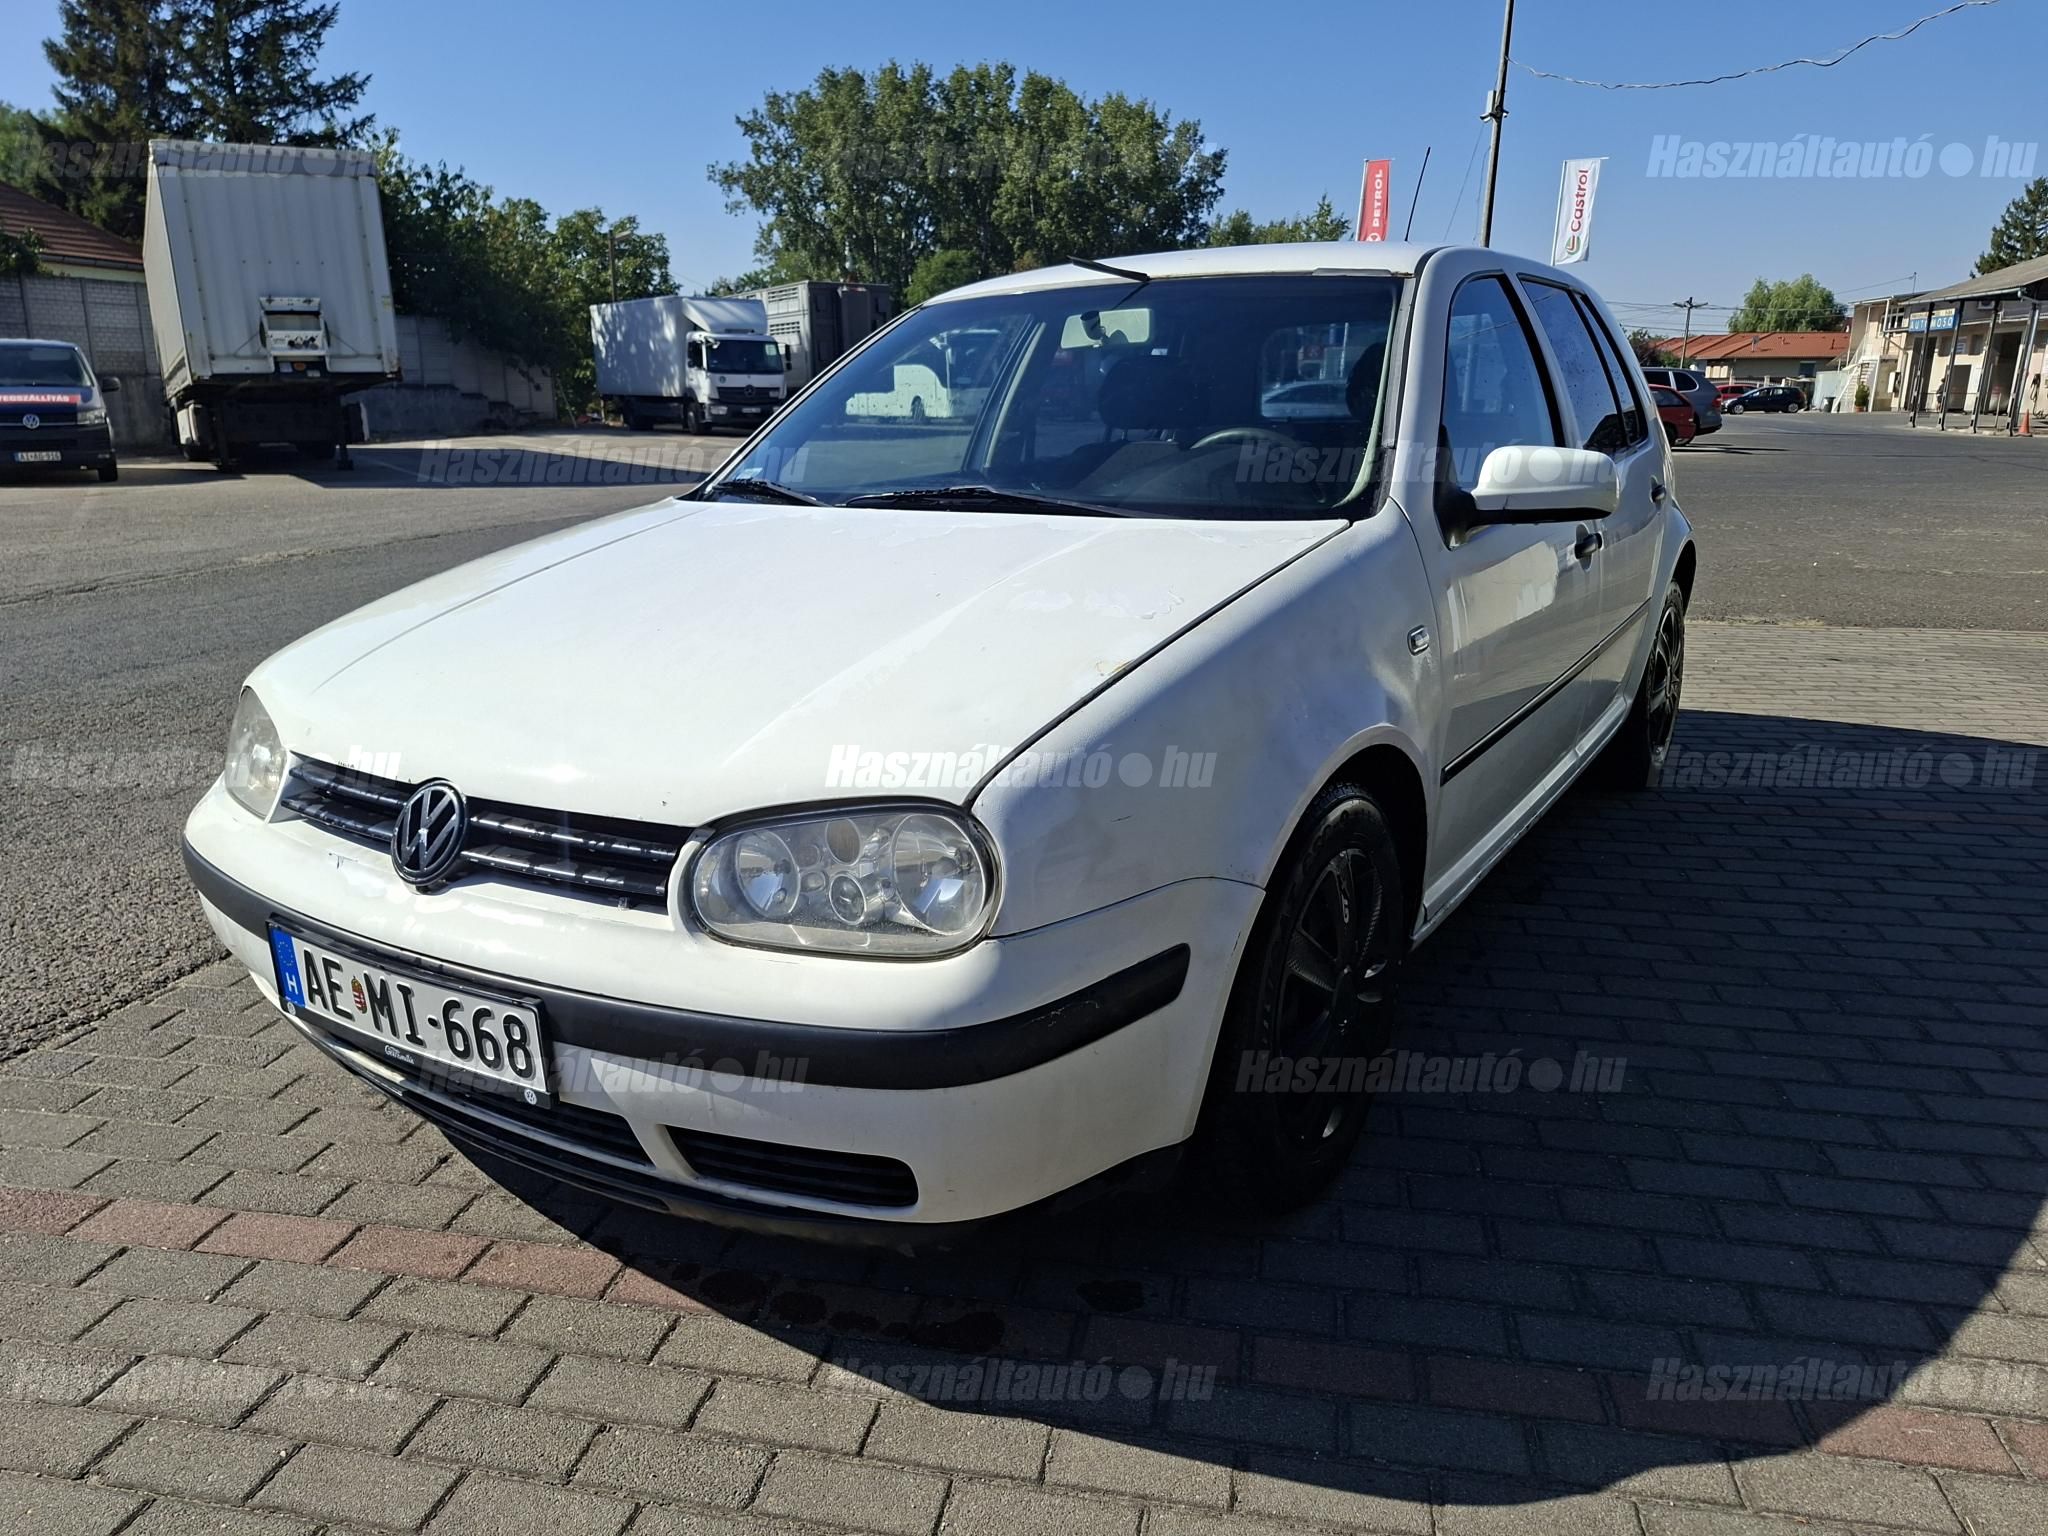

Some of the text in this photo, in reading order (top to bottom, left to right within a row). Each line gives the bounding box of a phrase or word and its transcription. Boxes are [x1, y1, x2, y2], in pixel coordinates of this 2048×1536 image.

[1372, 169, 1383, 227] PETROL
[1571, 169, 1589, 232] Castrol
[285, 971, 298, 996] H
